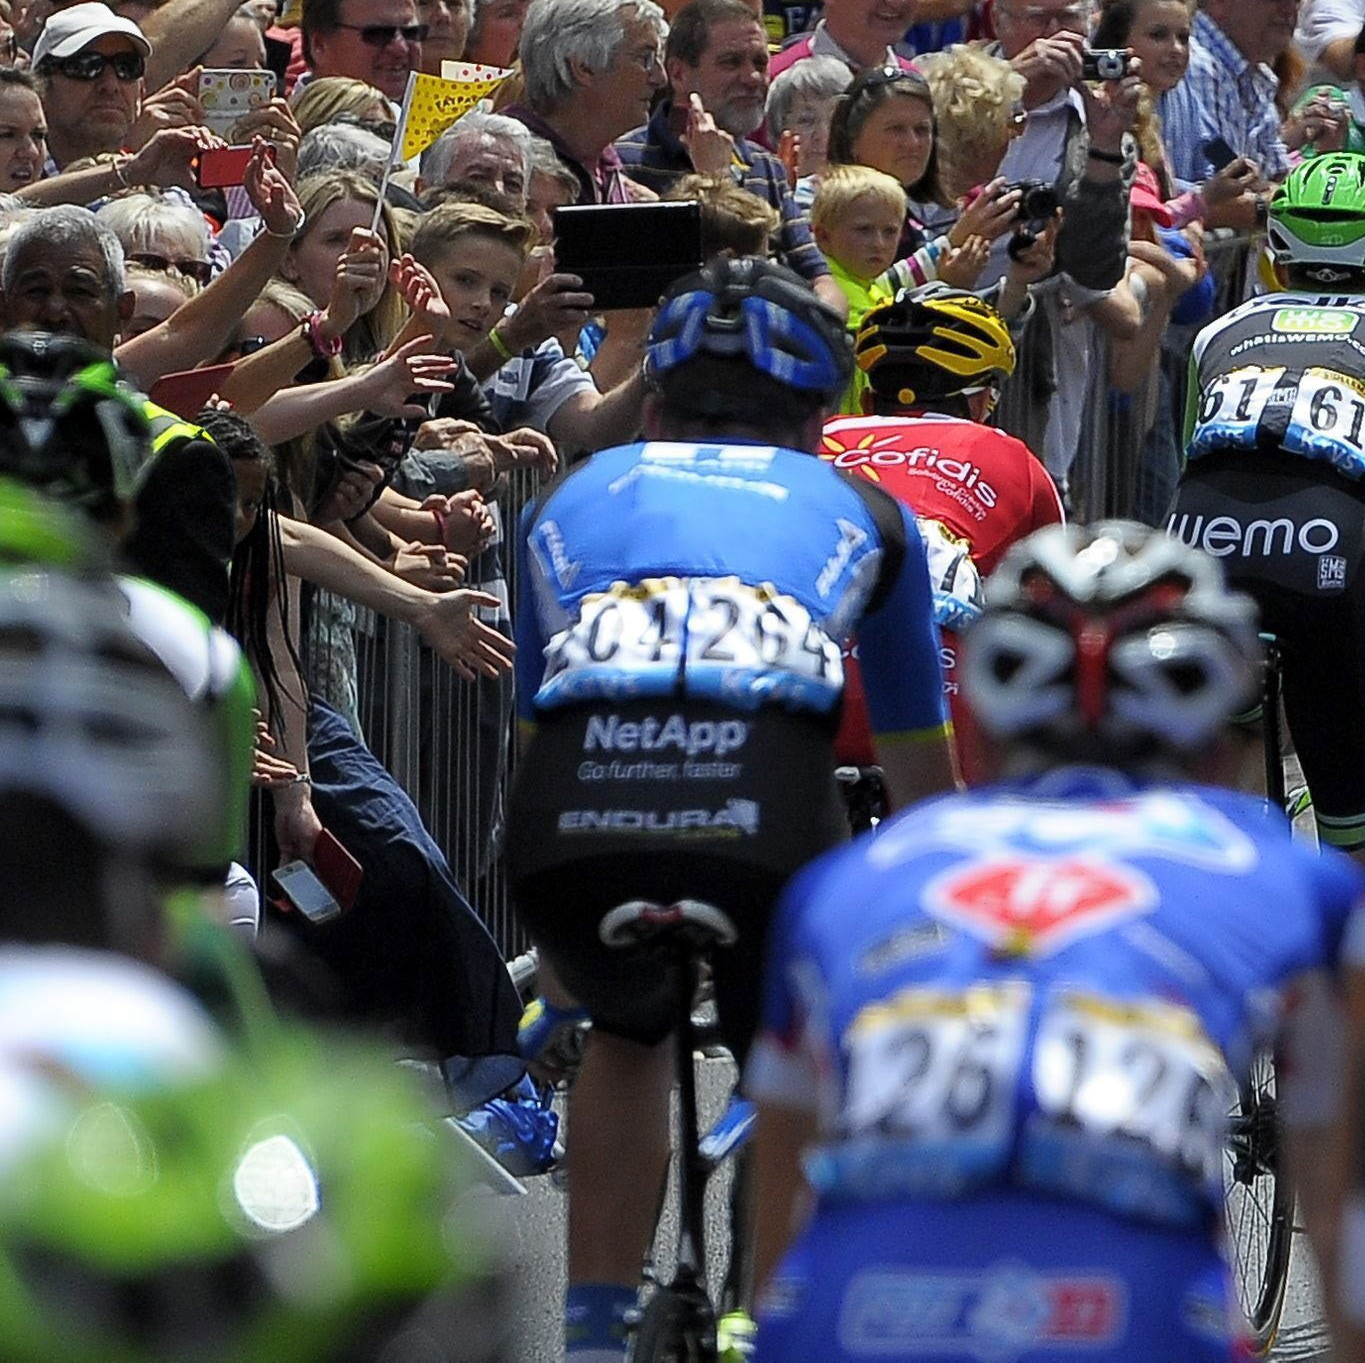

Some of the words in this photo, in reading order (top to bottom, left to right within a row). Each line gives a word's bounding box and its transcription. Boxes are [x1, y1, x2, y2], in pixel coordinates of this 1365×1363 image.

[1199, 377, 1258, 424] 61
[1308, 385, 1365, 450] 61
[833, 448, 996, 508] Cofidis
[1167, 514, 1339, 557] wemo
[583, 714, 748, 756] NetApp
[577, 761, 606, 781] Go
[557, 809, 744, 829] ENDURA
